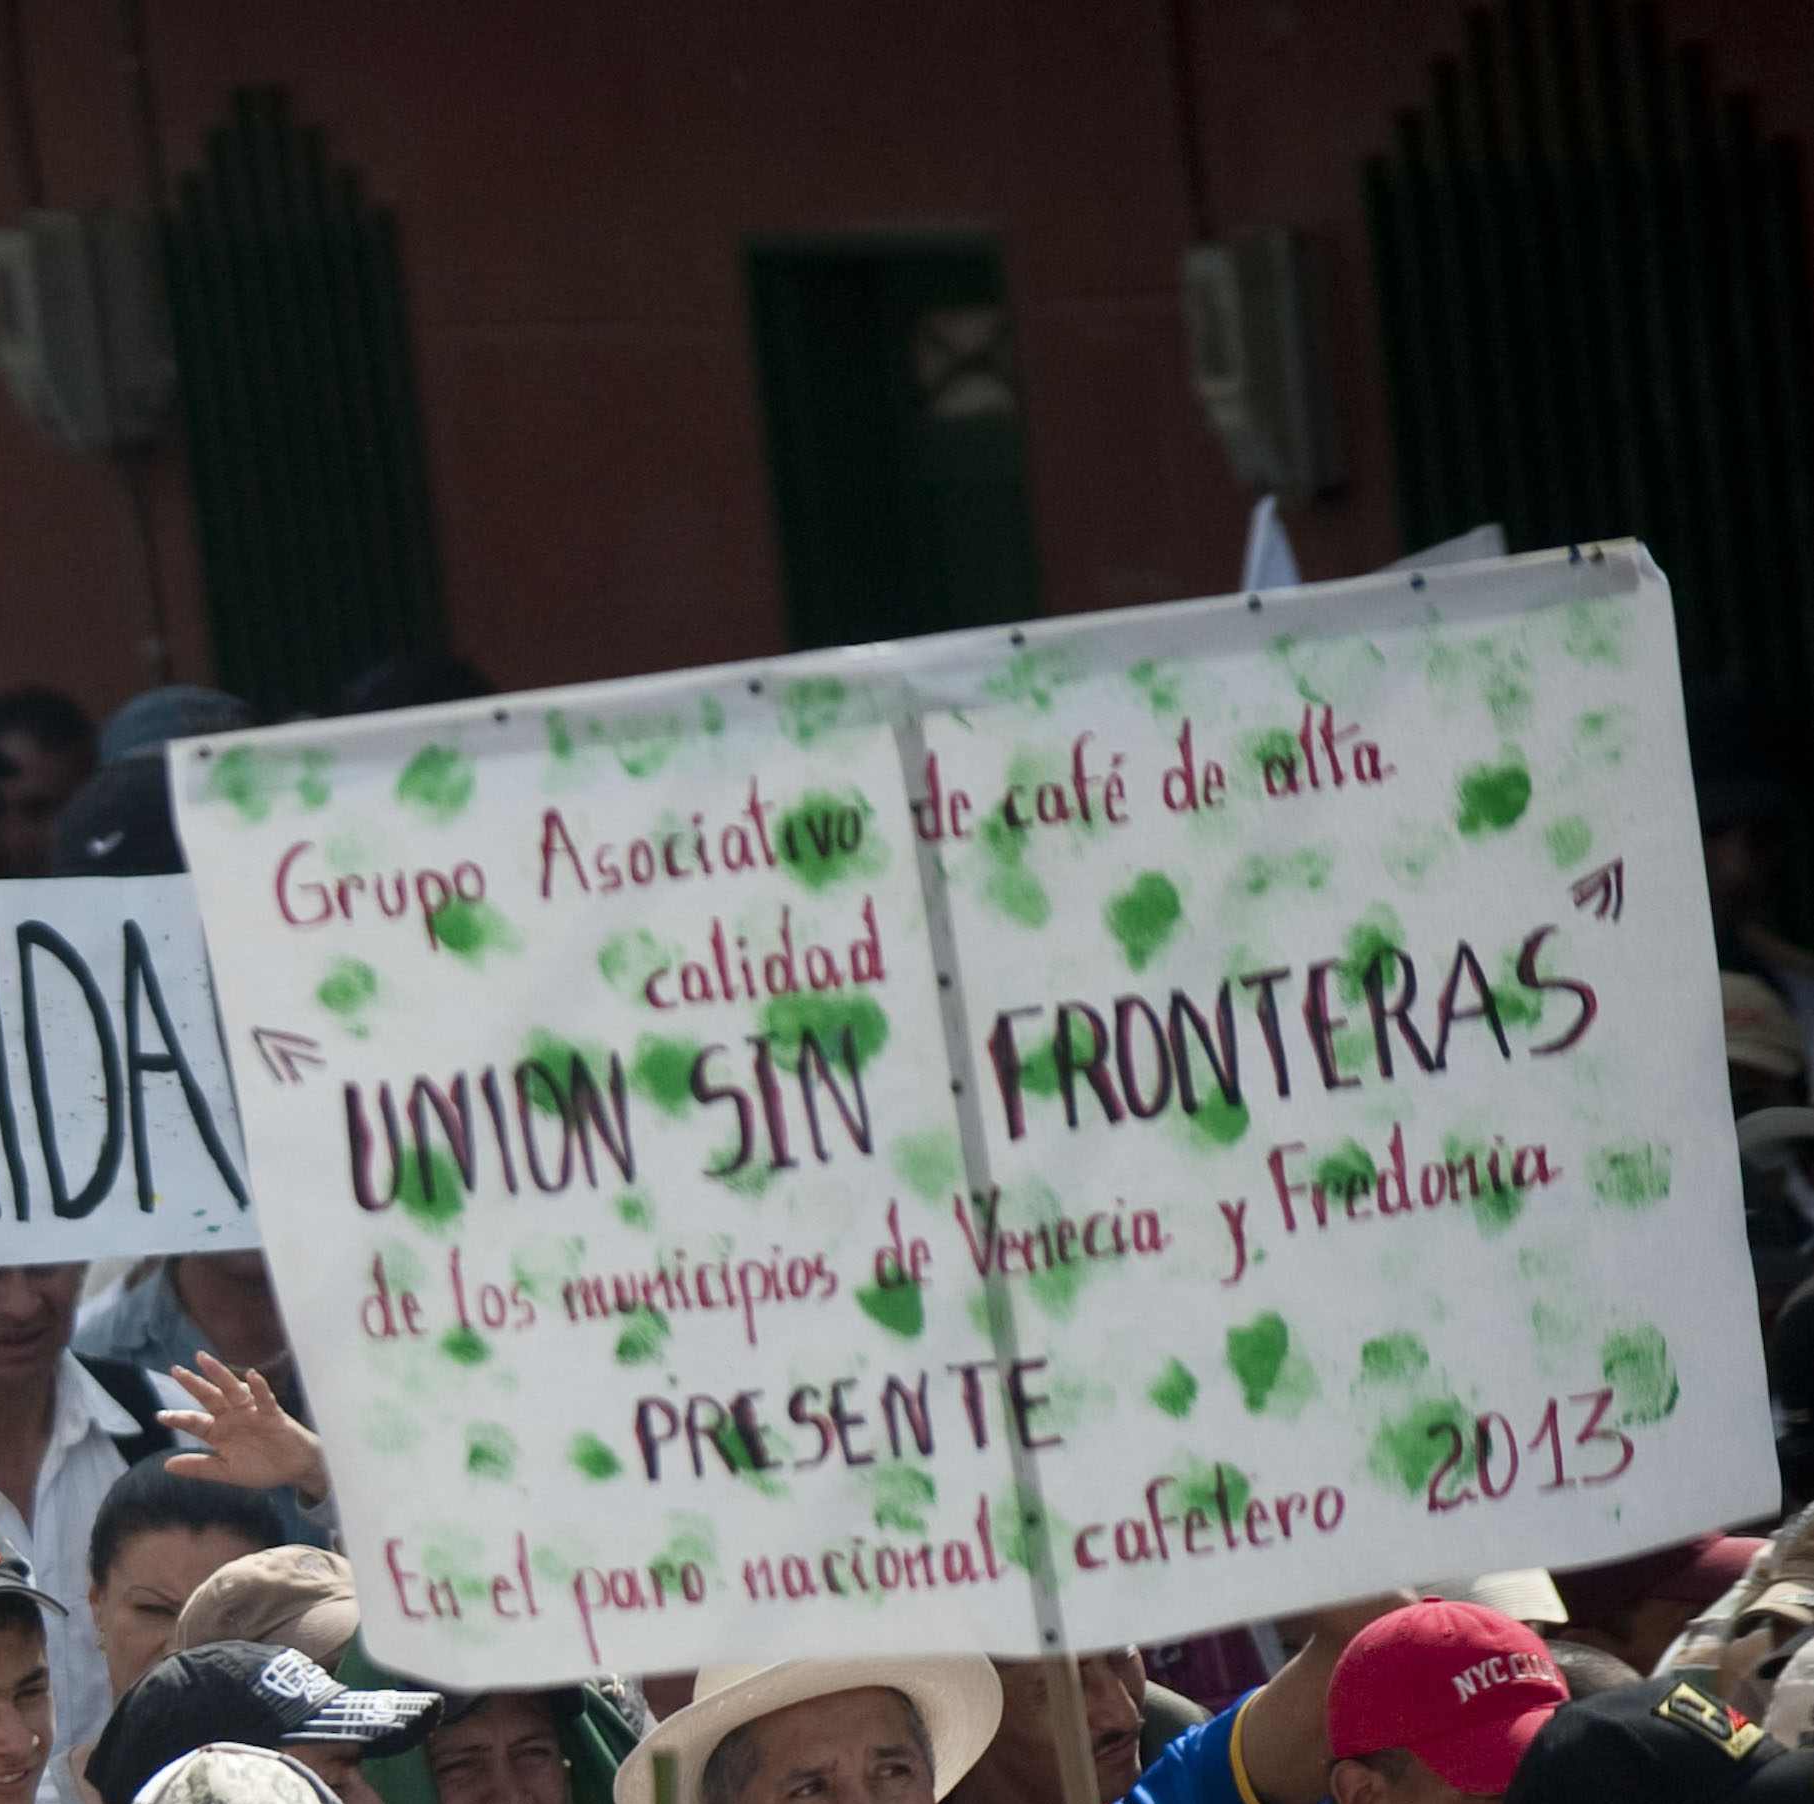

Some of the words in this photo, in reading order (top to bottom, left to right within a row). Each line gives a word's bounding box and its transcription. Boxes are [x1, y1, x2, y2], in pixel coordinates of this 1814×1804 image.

[275, 837, 485, 956] Grupo
[539, 774, 873, 899] Asociativo
[912, 749, 975, 844] de
[1006, 730, 1130, 830] café
[1161, 718, 1225, 812] de
[1262, 707, 1394, 791] alta
[645, 896, 887, 1010] calidad
[691, 1026, 873, 1180] SIN
[361, 1256, 426, 1339] de
[453, 1250, 537, 1332] los
[562, 1243, 839, 1346] municipios
[876, 1198, 932, 1293] de
[955, 1190, 1171, 1279] Venecia
[1218, 1200, 1249, 1285] y
[1267, 1122, 1556, 1236] Fredonia
[636, 1359, 1064, 1480] PRESENTE
[383, 1540, 463, 1623] En
[490, 1548, 538, 1623] el
[572, 1549, 706, 1663] paro
[744, 1497, 1003, 1601] nacional
[1077, 1461, 1345, 1573] cafetero
[1424, 1388, 1636, 1515] 2013
[1451, 1658, 1509, 1703] NYC
